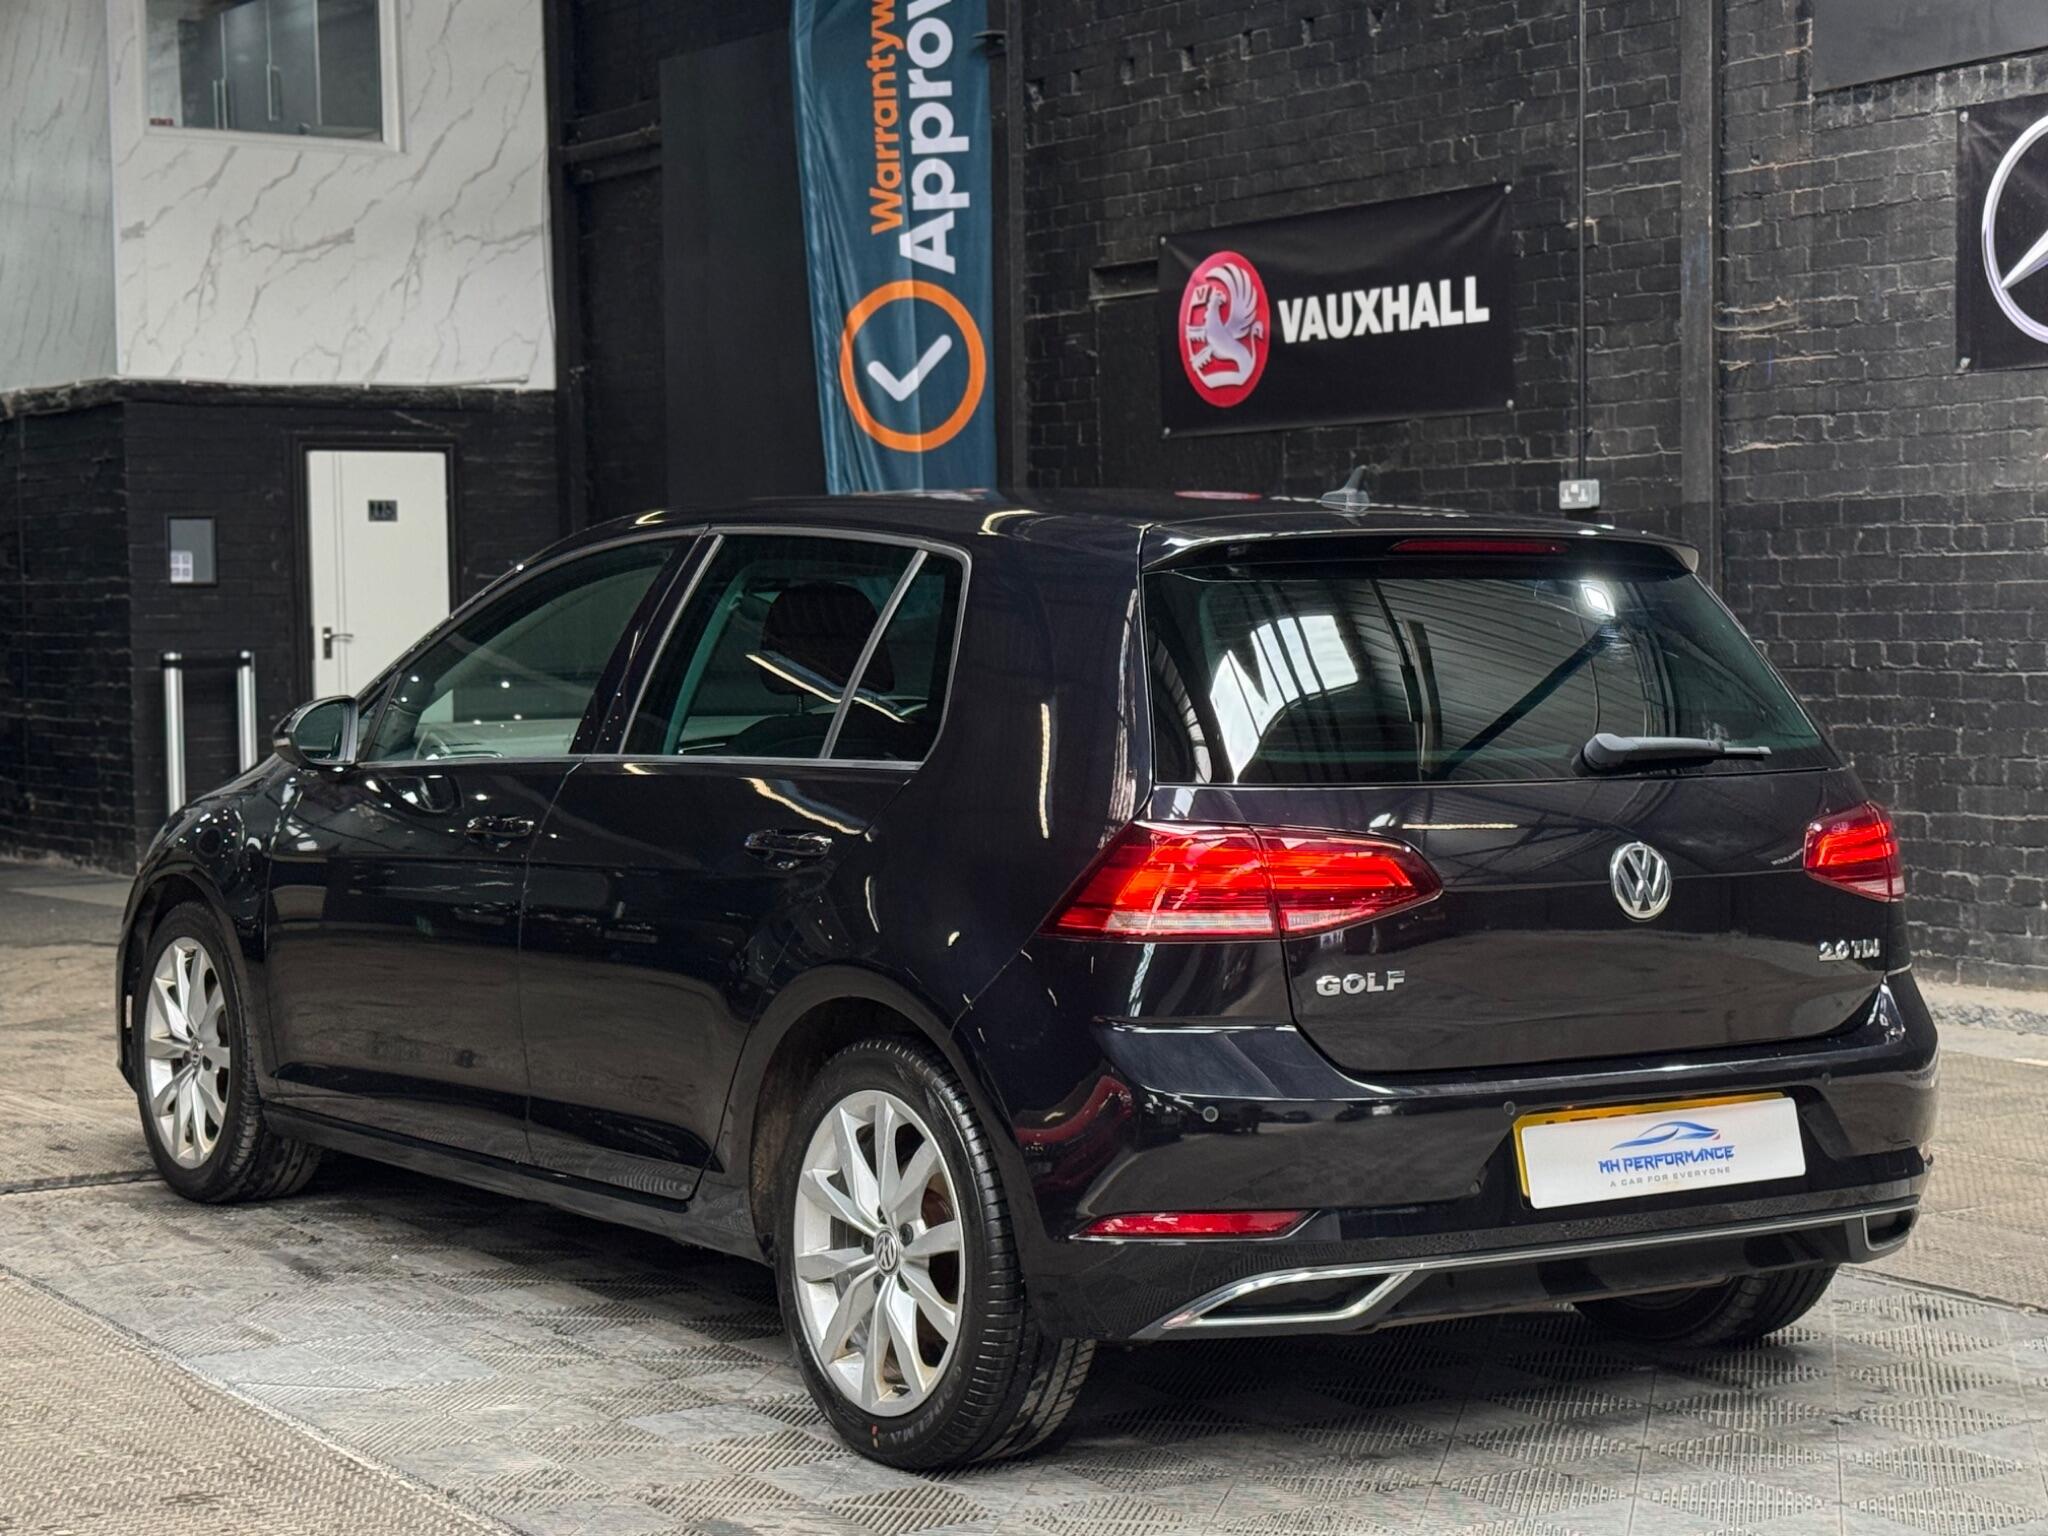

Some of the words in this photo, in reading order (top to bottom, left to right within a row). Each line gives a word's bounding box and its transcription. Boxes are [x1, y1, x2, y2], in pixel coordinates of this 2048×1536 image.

[866, 0, 904, 235] Warrantyw
[1278, 276, 1490, 344] VAUXHALL
[1850, 938, 1881, 959] TDI
[1315, 970, 1406, 996] GOLF
[1598, 1159, 1621, 1174] MH
[1621, 1145, 1736, 1174] PERFORMANCE
[1609, 1180, 1617, 1188] A
[1620, 1177, 1643, 1186] CAR
[1647, 1173, 1669, 1183] FOR
[1672, 1166, 1731, 1180] EVERYONE
